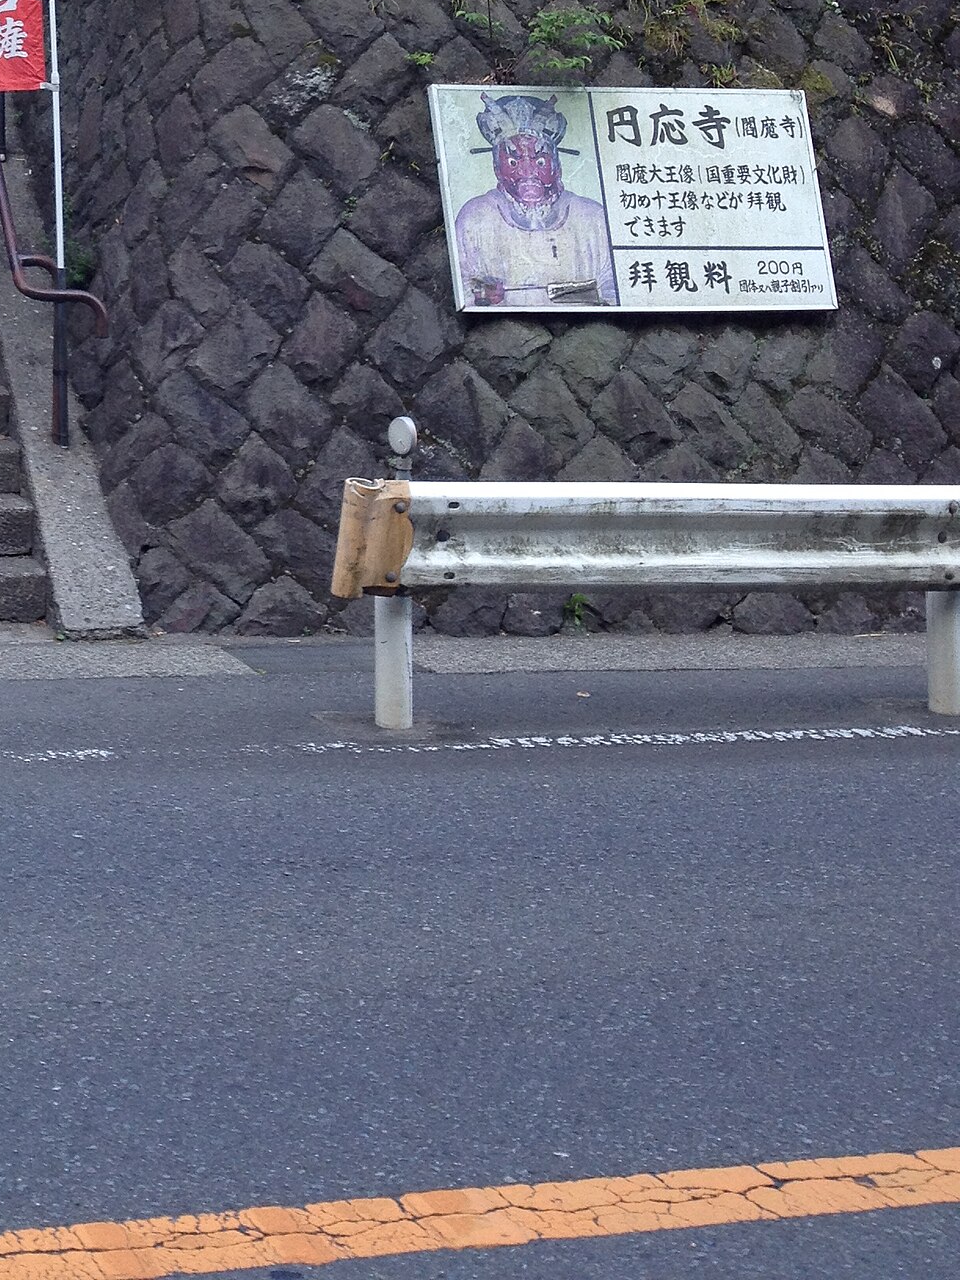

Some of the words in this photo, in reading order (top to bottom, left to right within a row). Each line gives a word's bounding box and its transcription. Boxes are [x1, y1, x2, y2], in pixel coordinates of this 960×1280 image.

[606, 103, 732, 150] 円応寺
[624, 215, 687, 238] できます
[628, 260, 733, 295] 拝観料
[756, 260, 804, 276] 200円
